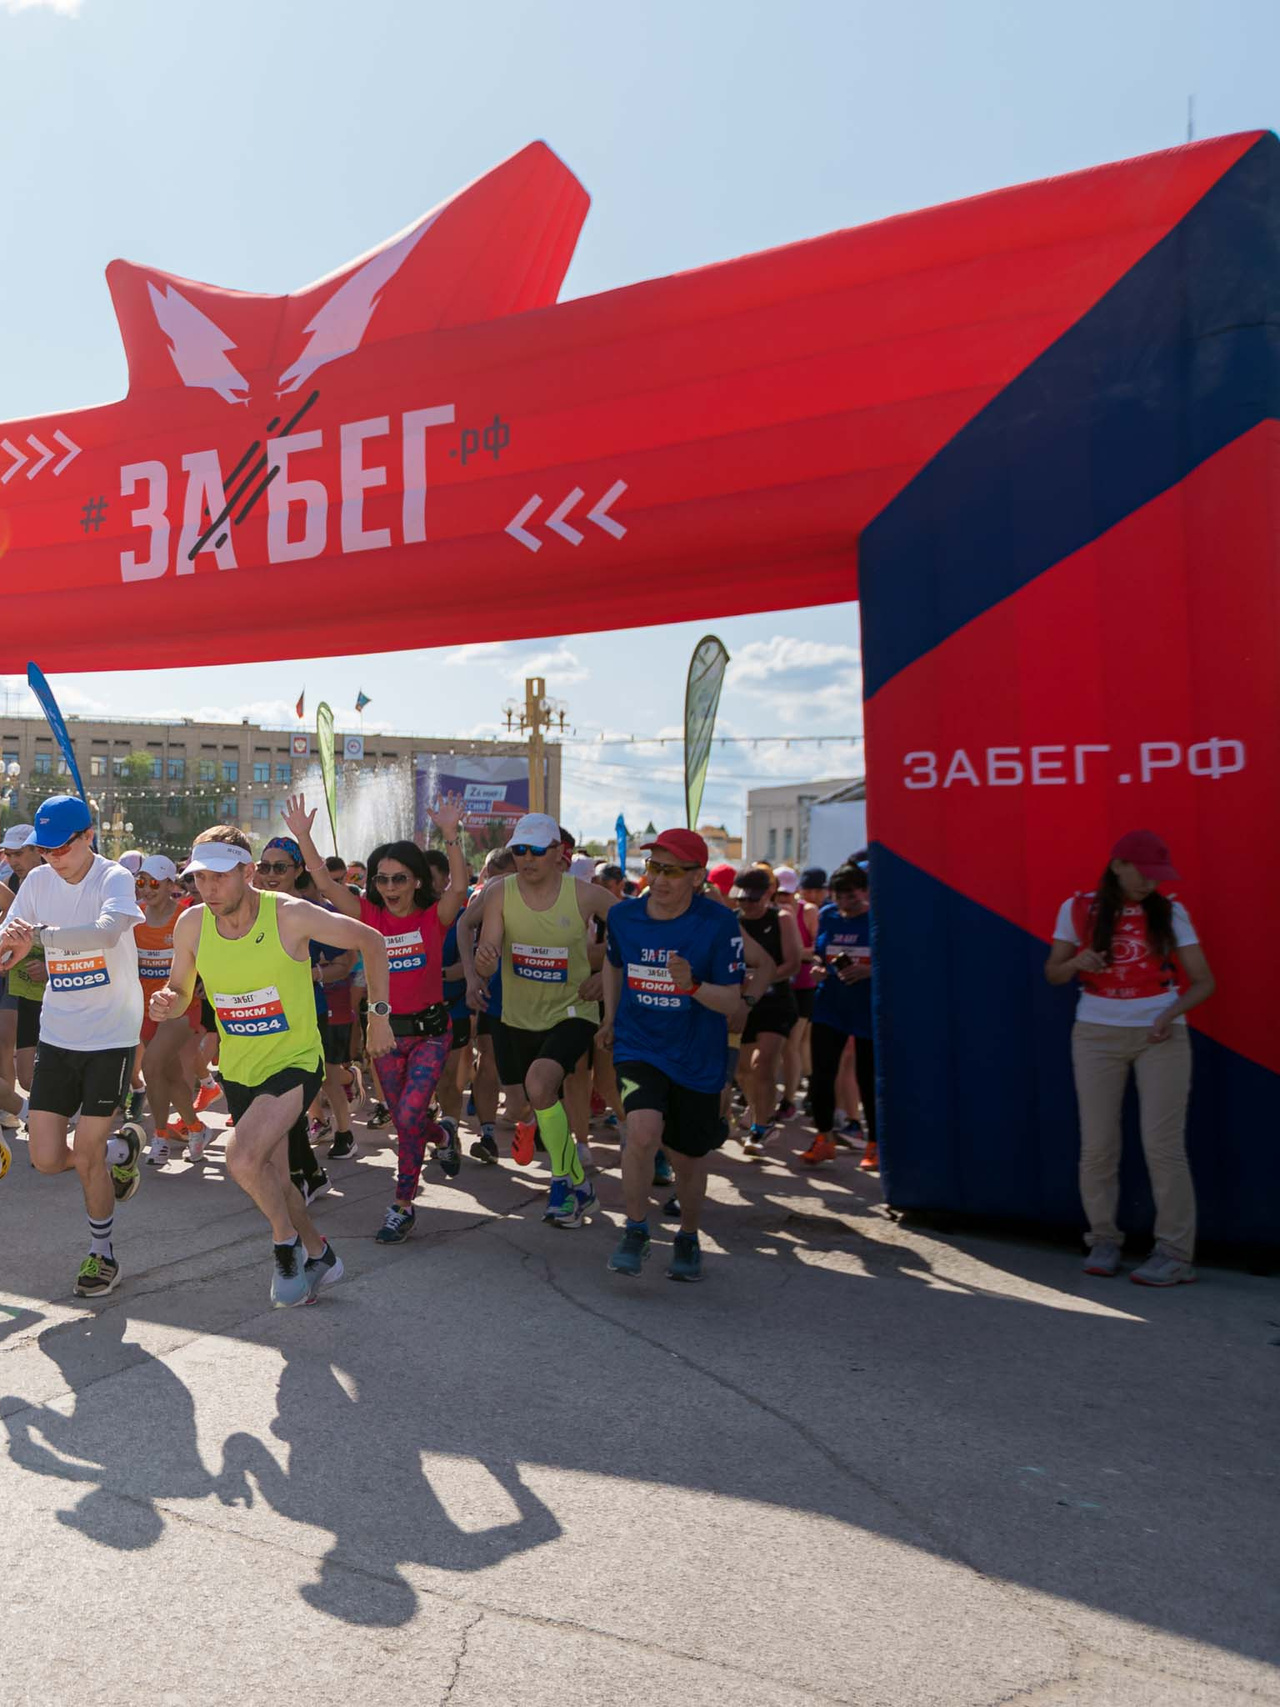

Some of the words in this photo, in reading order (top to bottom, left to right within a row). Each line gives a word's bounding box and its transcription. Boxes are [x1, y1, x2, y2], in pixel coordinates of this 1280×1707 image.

[903, 736, 1246, 790] ЗАБЕГ.РФ
[53, 973, 106, 988] 00029
[518, 967, 562, 980] 10022
[636, 994, 681, 1007] 10133
[227, 1019, 282, 1033] 10024
